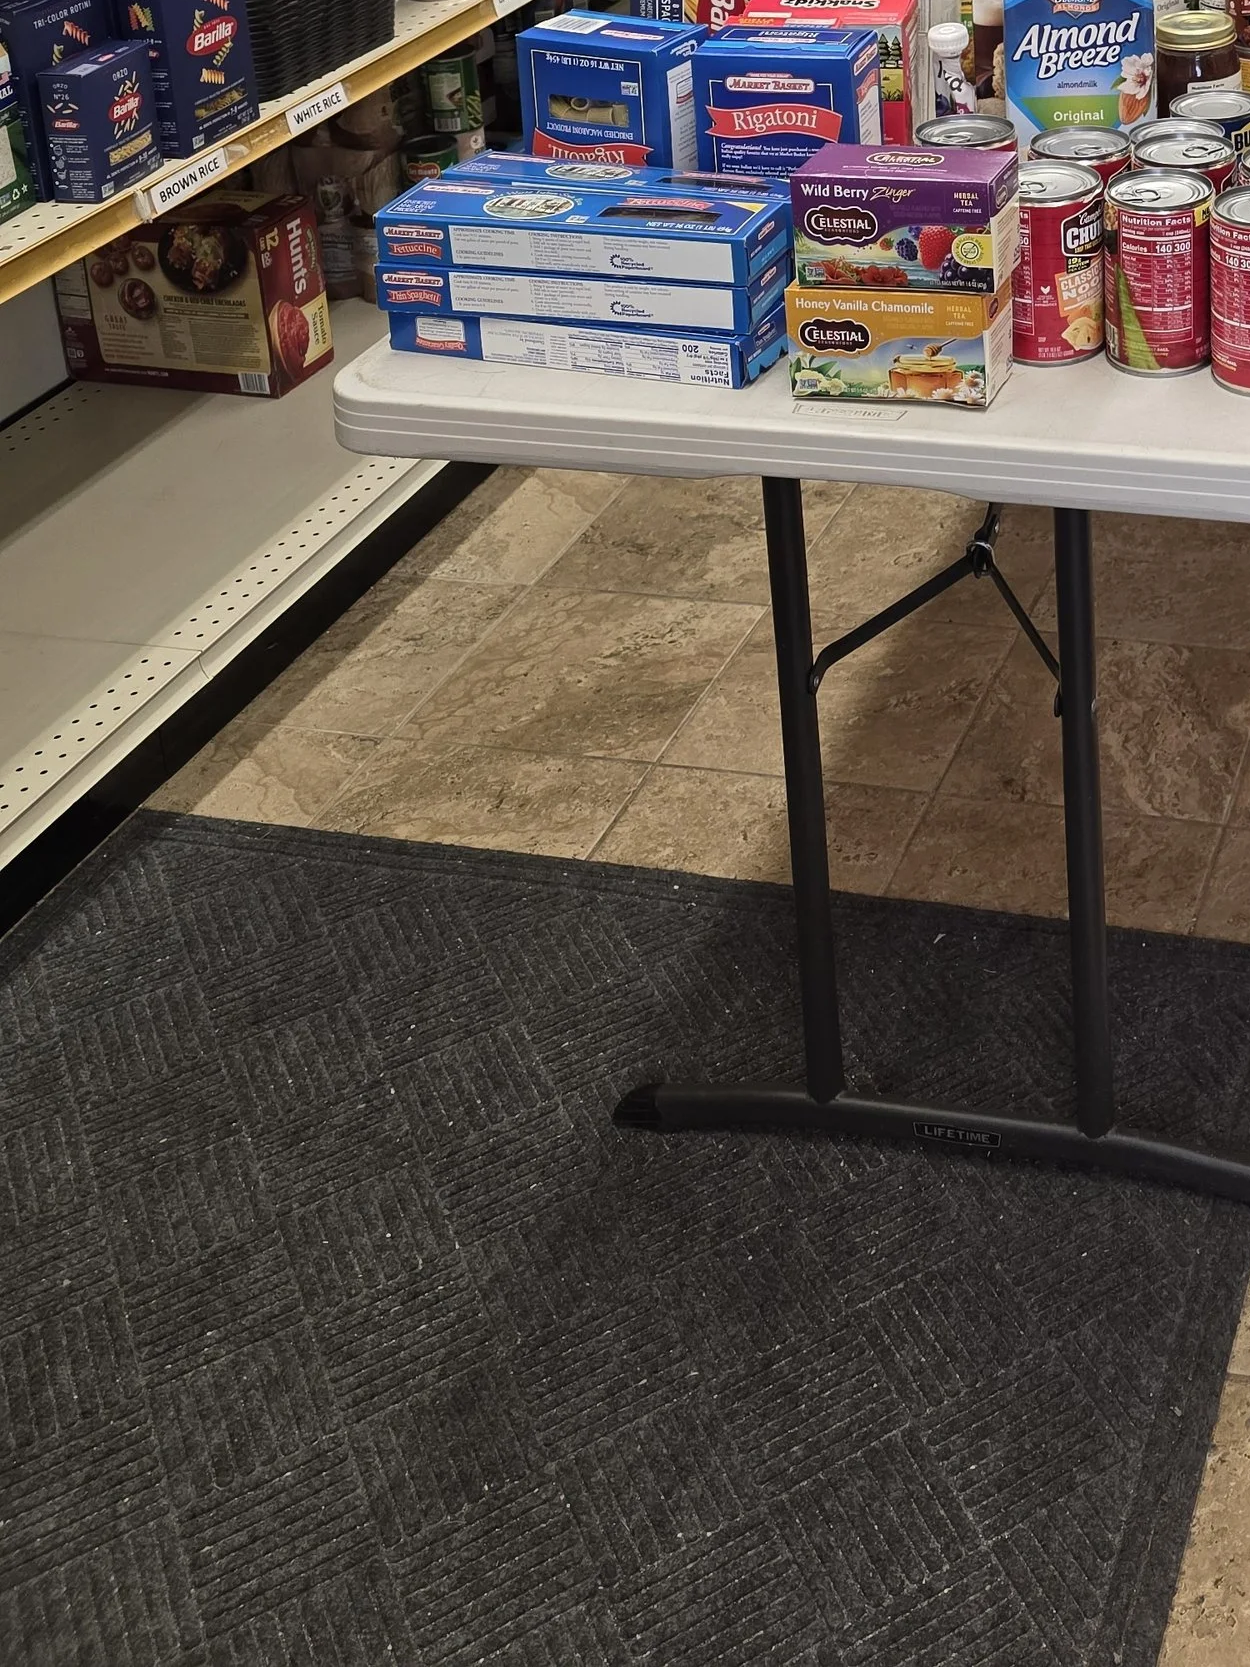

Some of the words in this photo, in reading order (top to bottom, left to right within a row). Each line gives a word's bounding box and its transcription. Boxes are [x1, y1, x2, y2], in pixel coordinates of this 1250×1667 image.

[33, 8, 69, 29] TRI-COLOR
[69, 0, 92, 16] ROTINI
[194, 21, 235, 52] Barilla
[1013, 12, 1140, 62] Almond
[1037, 44, 1122, 80] Breeze
[112, 67, 129, 82] ORZO
[729, 78, 772, 90] MARKET
[772, 79, 811, 91] BASKET
[1056, 81, 1099, 90] almondmilk
[113, 96, 141, 121] Barilla
[293, 100, 322, 125] WHITE
[322, 90, 343, 110] RICE
[731, 109, 818, 133] Rigatoni
[1053, 110, 1105, 124] Original
[546, 122, 572, 133] PRODUCT
[159, 173, 196, 203] BROWN
[196, 158, 220, 180] RICE
[800, 182, 831, 199] Wild
[833, 185, 869, 202] Berry
[869, 185, 915, 204] Zinger
[953, 192, 979, 201] HERBAL
[960, 199, 974, 207] TEA
[810, 213, 872, 231] CELESTIAL
[1122, 215, 1163, 227] Nutrition
[1165, 217, 1192, 226] Facts
[265, 226, 280, 252] 12
[385, 227, 414, 237] MARKET
[414, 229, 442, 239] BASKET
[391, 242, 438, 255] Fettuccine
[1122, 241, 1148, 253] Calories
[1155, 244, 1172, 254] 140
[1174, 241, 1191, 252] 300
[1225, 255, 1240, 267] 140
[384, 275, 414, 284] MARKET
[390, 291, 407, 301] Thin
[406, 291, 439, 304] Spaghetti
[795, 297, 831, 312] Honey
[832, 298, 869, 312] Vanilla
[871, 300, 935, 315] Chamomile
[946, 305, 972, 314] HERBAL
[953, 312, 966, 320] TEA
[311, 311, 321, 345] Sauce
[316, 302, 327, 345] Tomato
[804, 325, 865, 343] CELESTIAL
[682, 343, 699, 354] 200
[690, 373, 731, 387] Nutrition
[704, 368, 730, 378] Facts
[923, 1124, 991, 1145] LIFETIME
